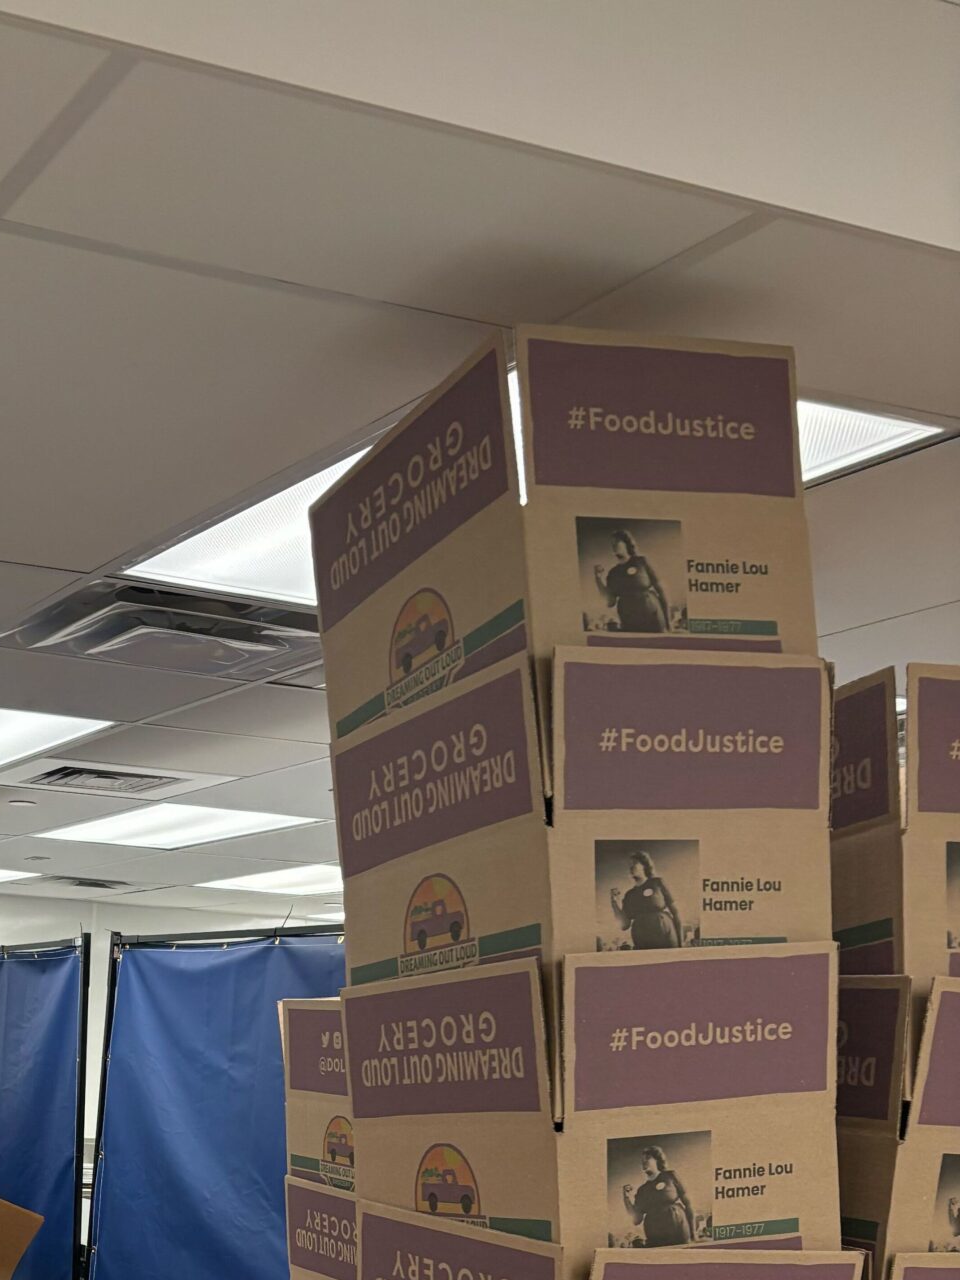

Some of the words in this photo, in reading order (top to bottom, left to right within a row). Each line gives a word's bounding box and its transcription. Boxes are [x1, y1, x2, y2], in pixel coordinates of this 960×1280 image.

[568, 406, 755, 440] #FoodJustice
[346, 421, 463, 543] GROCERY
[403, 434, 492, 533] DREAMING
[370, 512, 401, 561] OUT
[330, 538, 368, 590] LOUD
[687, 559, 739, 575] Fannie
[742, 561, 768, 575] Lou
[688, 579, 741, 594] Hamer
[599, 728, 784, 753] #FoodJustice
[369, 723, 487, 800] GROCERY
[426, 750, 516, 814] DREAMING
[352, 801, 390, 841] LOUD
[393, 788, 424, 826] OUT
[702, 877, 753, 892] Fannie
[757, 879, 781, 892] Lou
[702, 898, 754, 912] Hamer
[400, 952, 438, 974] DREAMING
[456, 943, 477, 962] LOUD
[378, 1011, 496, 1052] GROCERY
[609, 1018, 793, 1051] #FoodJustice
[361, 1056, 400, 1087] LOUD
[402, 1054, 432, 1085] OUT
[437, 1046, 524, 1082] DREAMING
[714, 1163, 765, 1181] Fannie
[768, 1162, 793, 1176] Lou
[714, 1183, 767, 1200] Hamer
[296, 1228, 318, 1255] LOUD
[715, 1223, 765, 1239] 1917-1977
